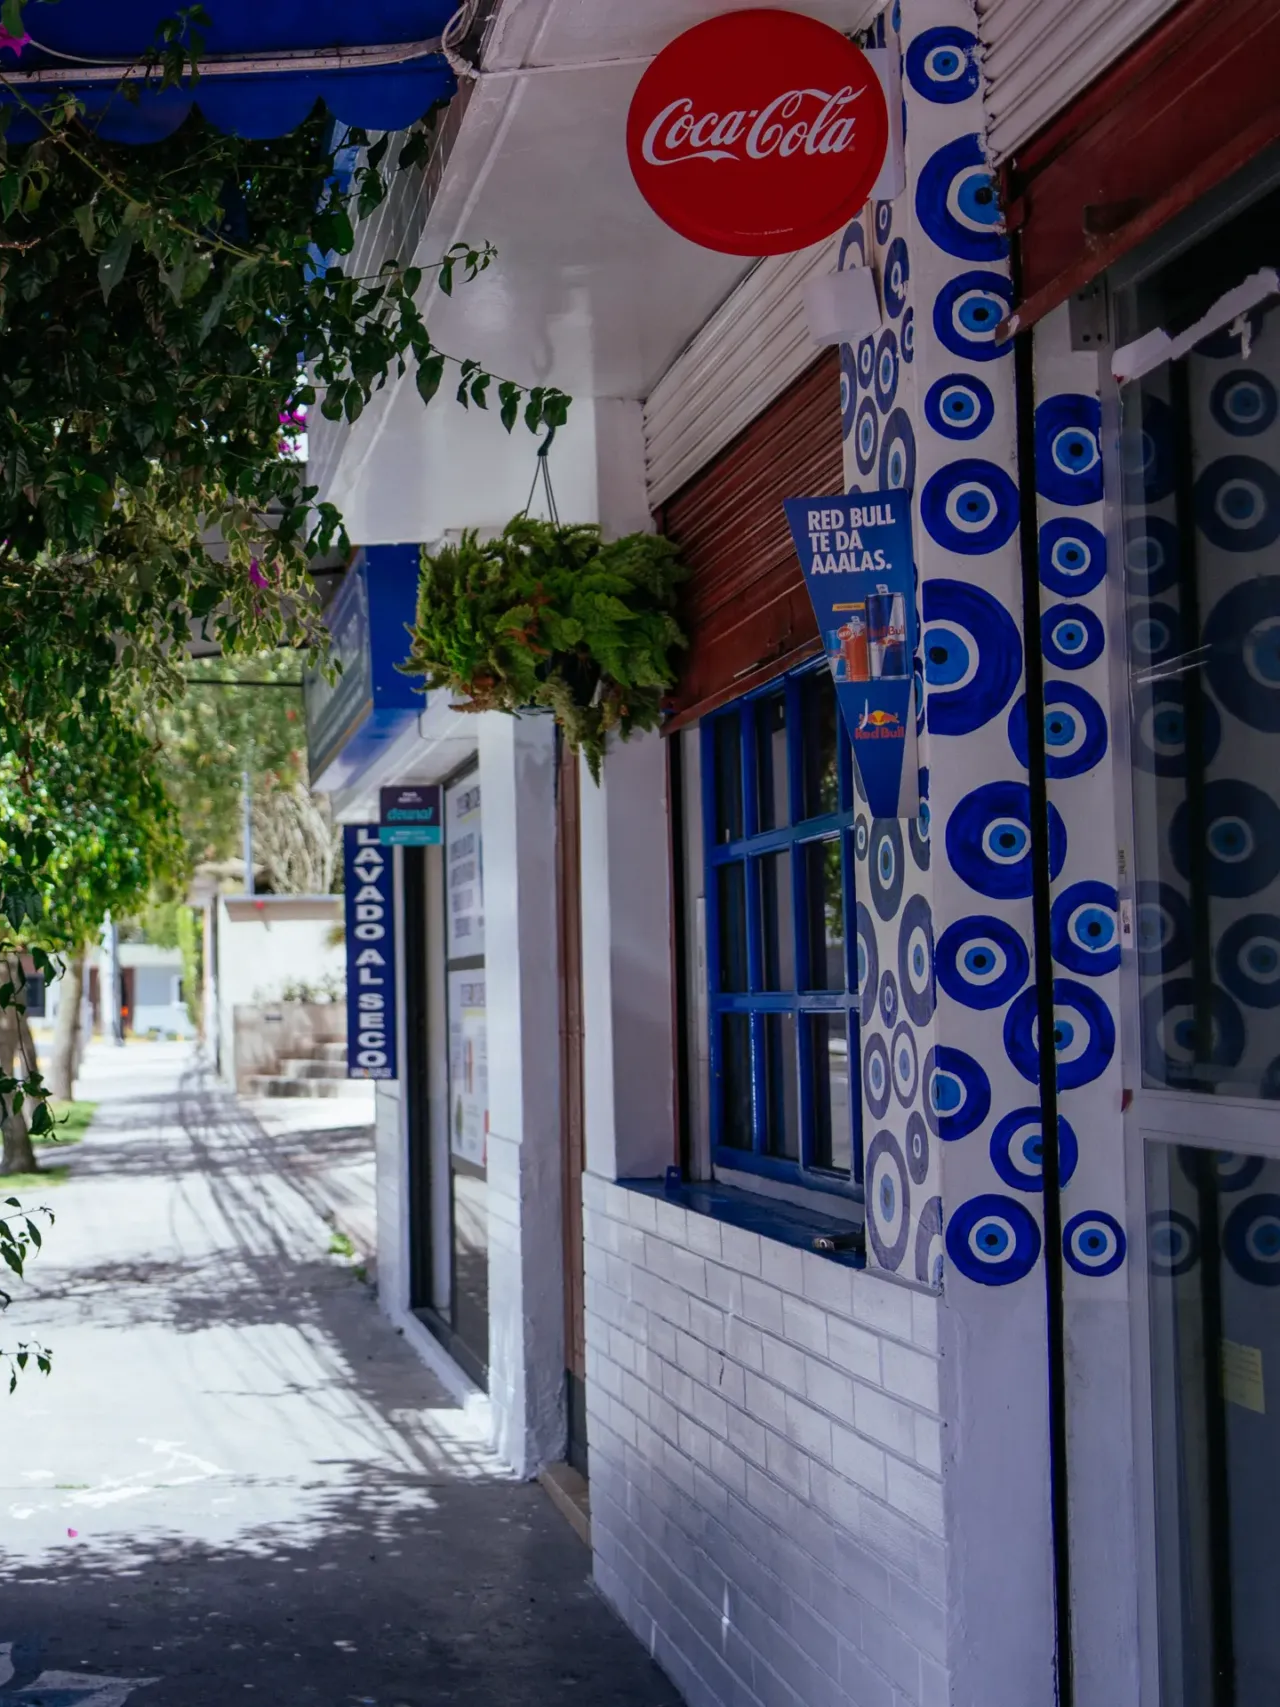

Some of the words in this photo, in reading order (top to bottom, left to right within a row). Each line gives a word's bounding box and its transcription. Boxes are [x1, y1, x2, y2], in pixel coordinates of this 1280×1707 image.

[642, 85, 867, 166] Coca-Cola
[808, 509, 844, 531] RED
[850, 504, 896, 527] BULL
[808, 531, 831, 552] TE
[836, 529, 863, 551] DA
[810, 549, 892, 575] AAALAS.
[855, 727, 879, 739] Red
[881, 726, 904, 739] Bull
[354, 828, 385, 940] LAVADO
[355, 948, 385, 985] AL
[357, 993, 387, 1067] SECO
